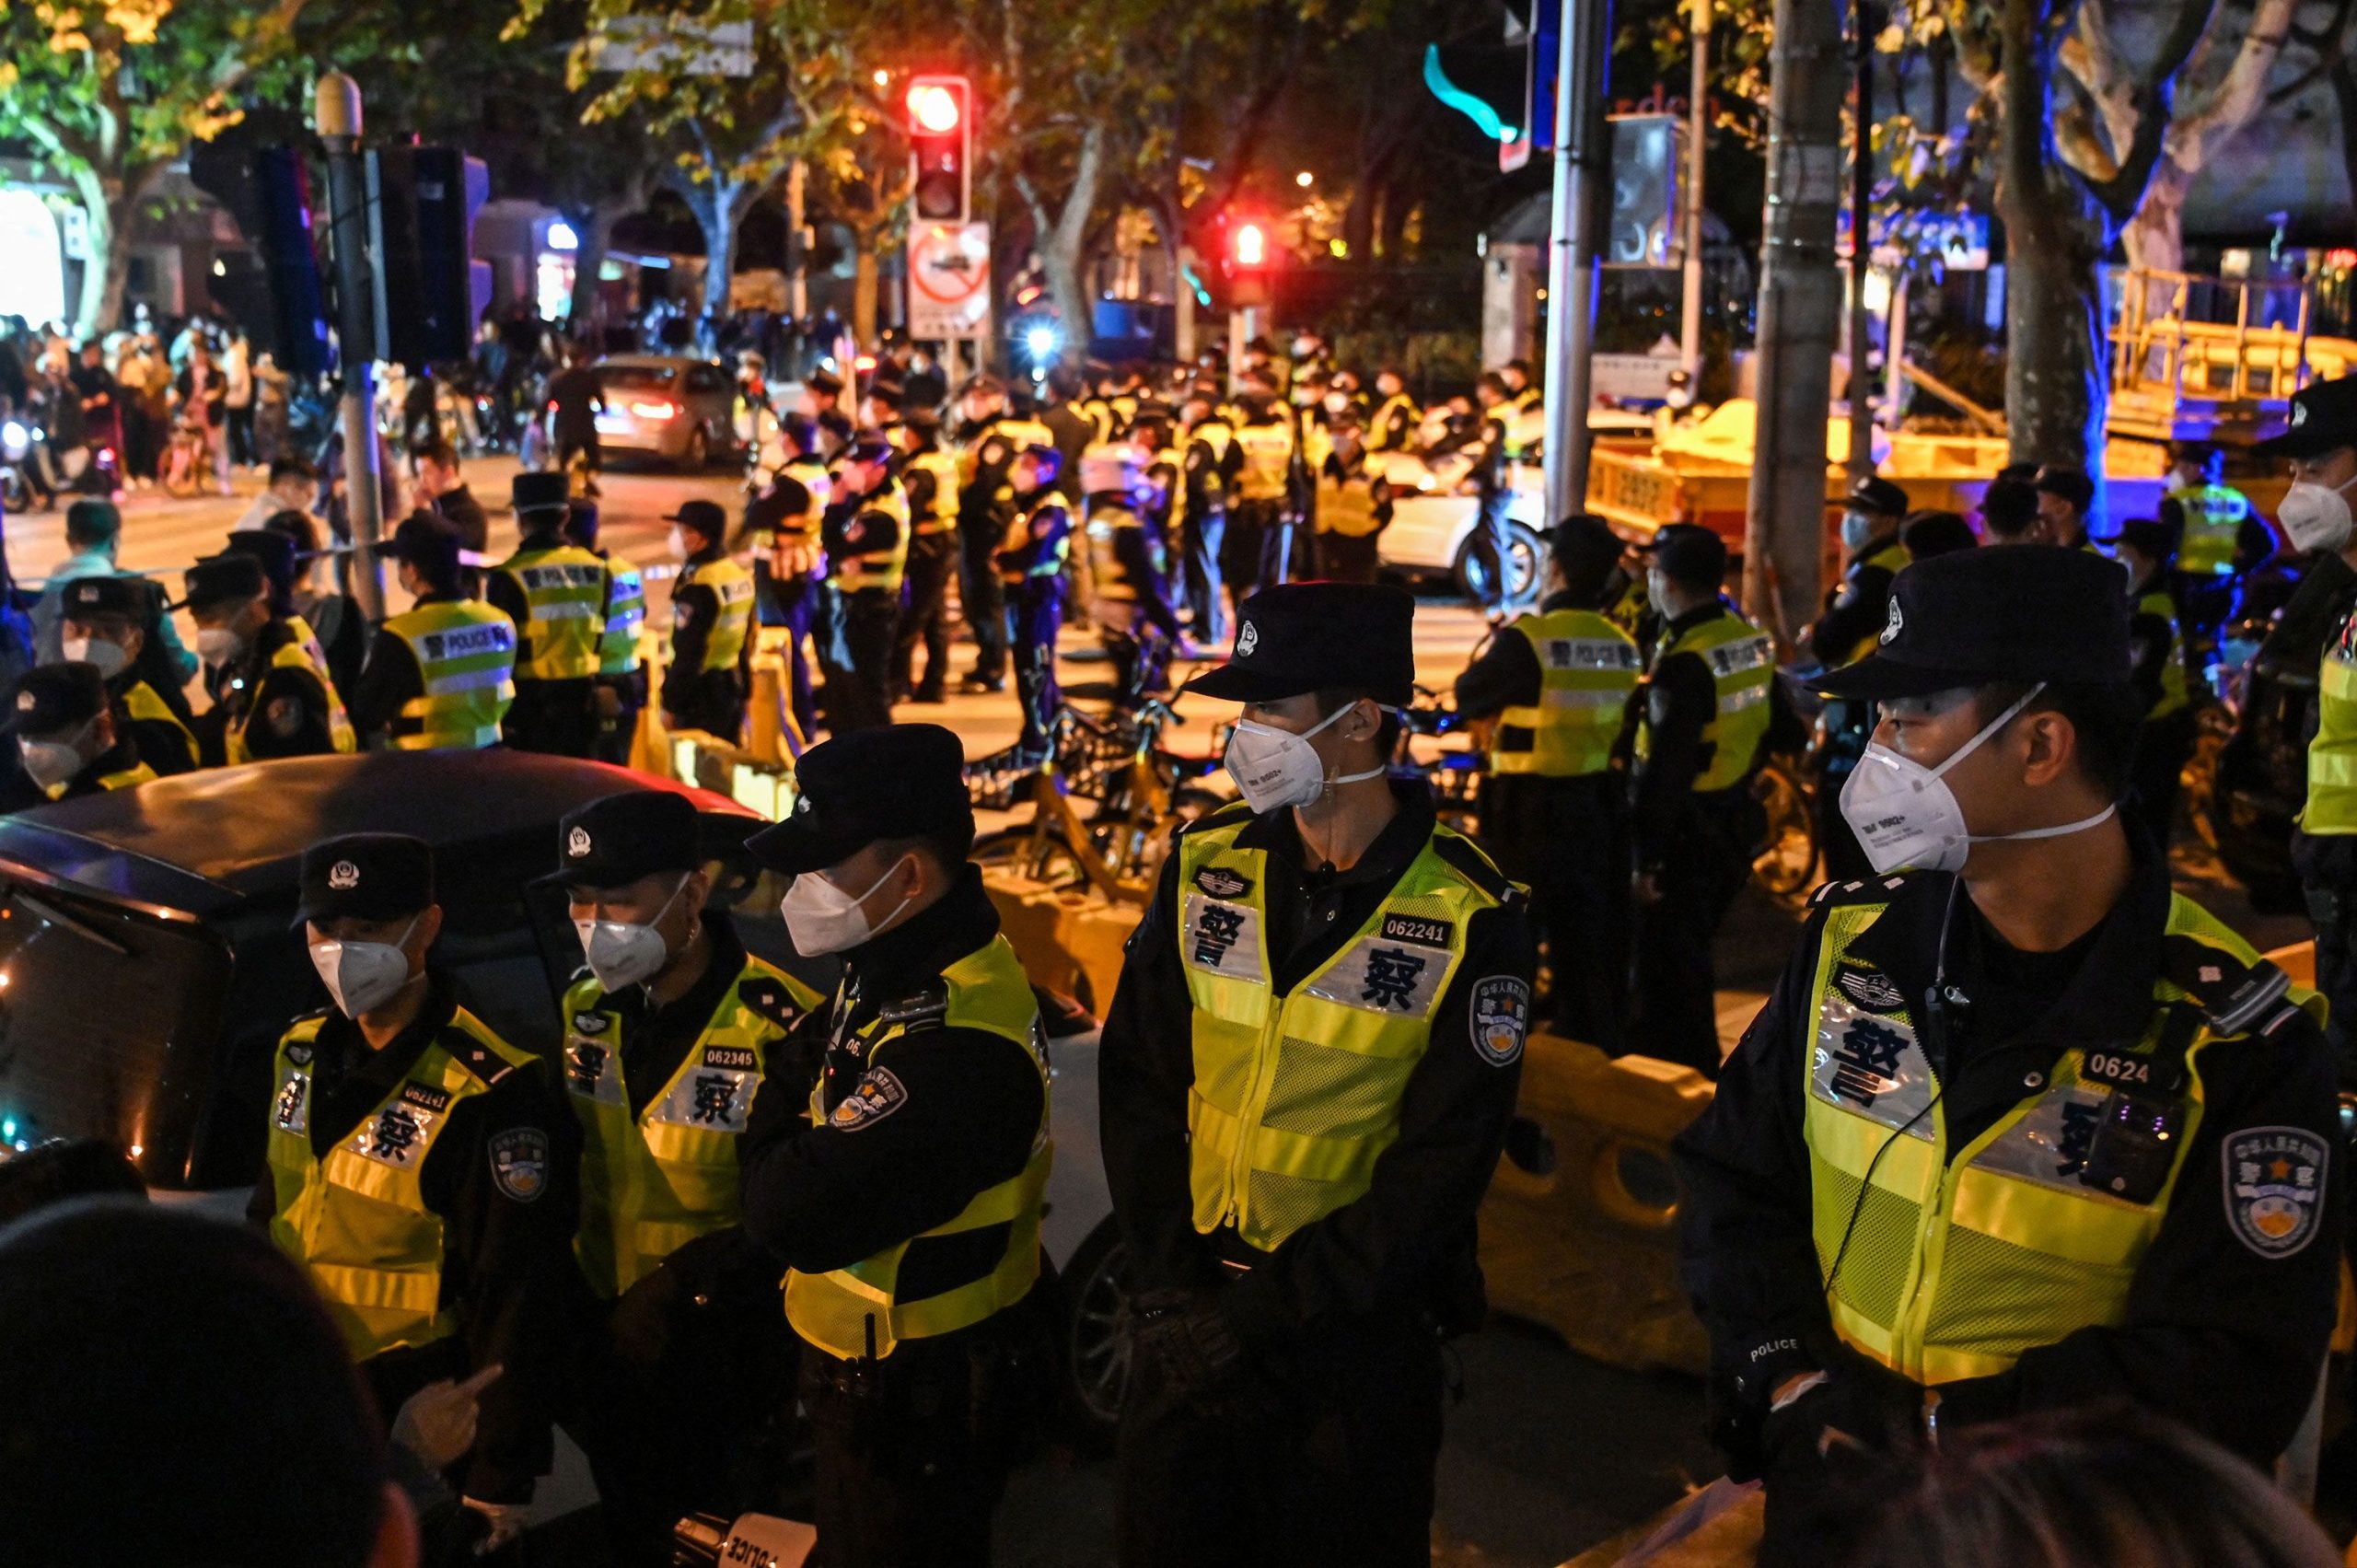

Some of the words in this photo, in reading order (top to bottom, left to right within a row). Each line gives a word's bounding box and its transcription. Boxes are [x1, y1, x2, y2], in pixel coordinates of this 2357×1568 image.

[448, 632, 489, 650] POLICE
[1194, 904, 1246, 968] 警
[1387, 919, 1445, 943] 062241
[1361, 948, 1426, 1011] 察
[1830, 1016, 1910, 1109] 警
[693, 1074, 742, 1124] 察
[372, 1109, 420, 1163] 察
[1750, 1338, 1798, 1363] POLICE
